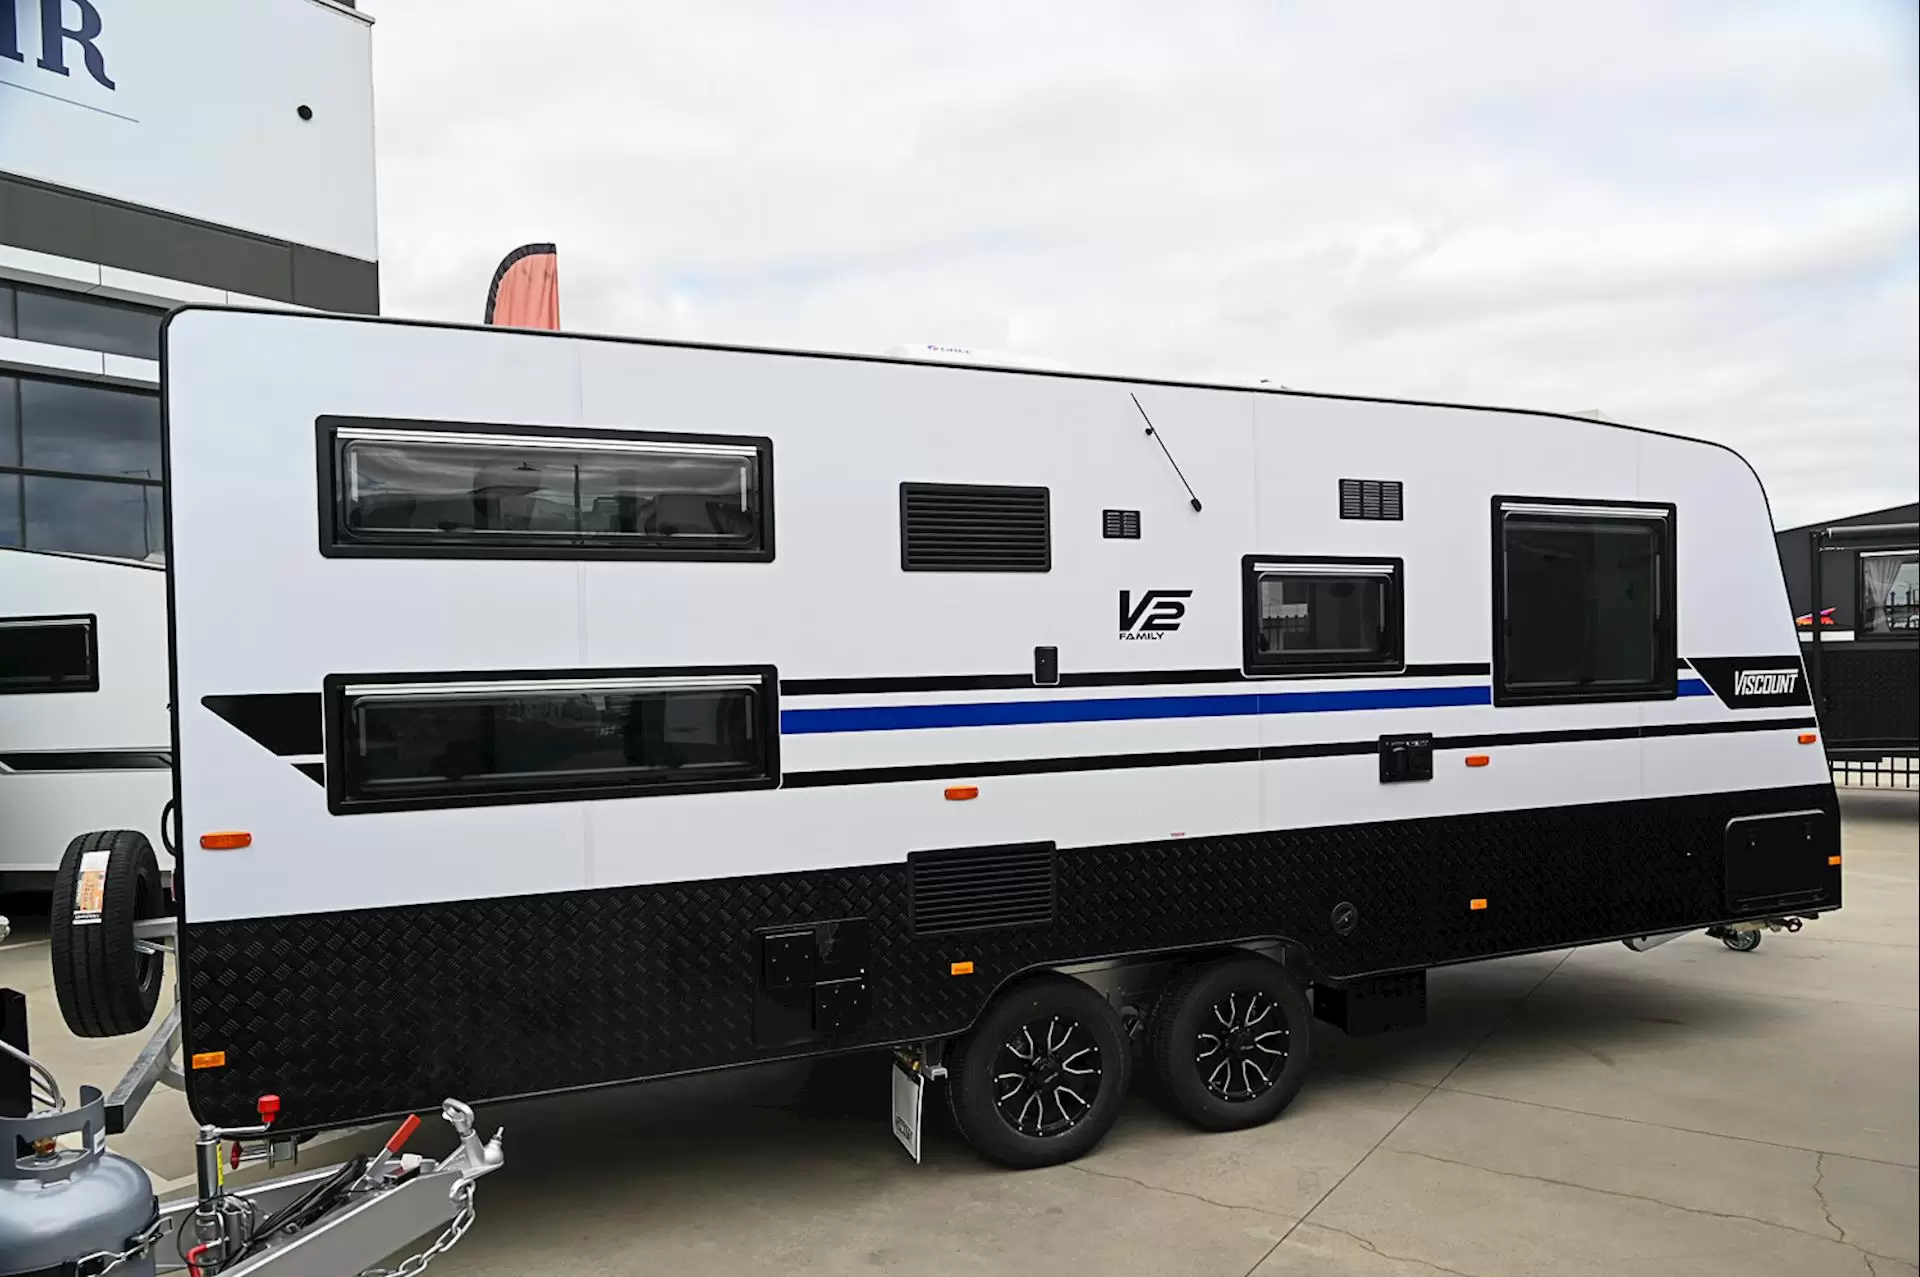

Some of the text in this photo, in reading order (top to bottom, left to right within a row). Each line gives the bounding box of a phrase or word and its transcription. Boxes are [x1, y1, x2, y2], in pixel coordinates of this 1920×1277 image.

[1119, 590, 1193, 631] V2
[1119, 631, 1165, 641] FAMILY
[1734, 668, 1799, 696] VISCOUNT
